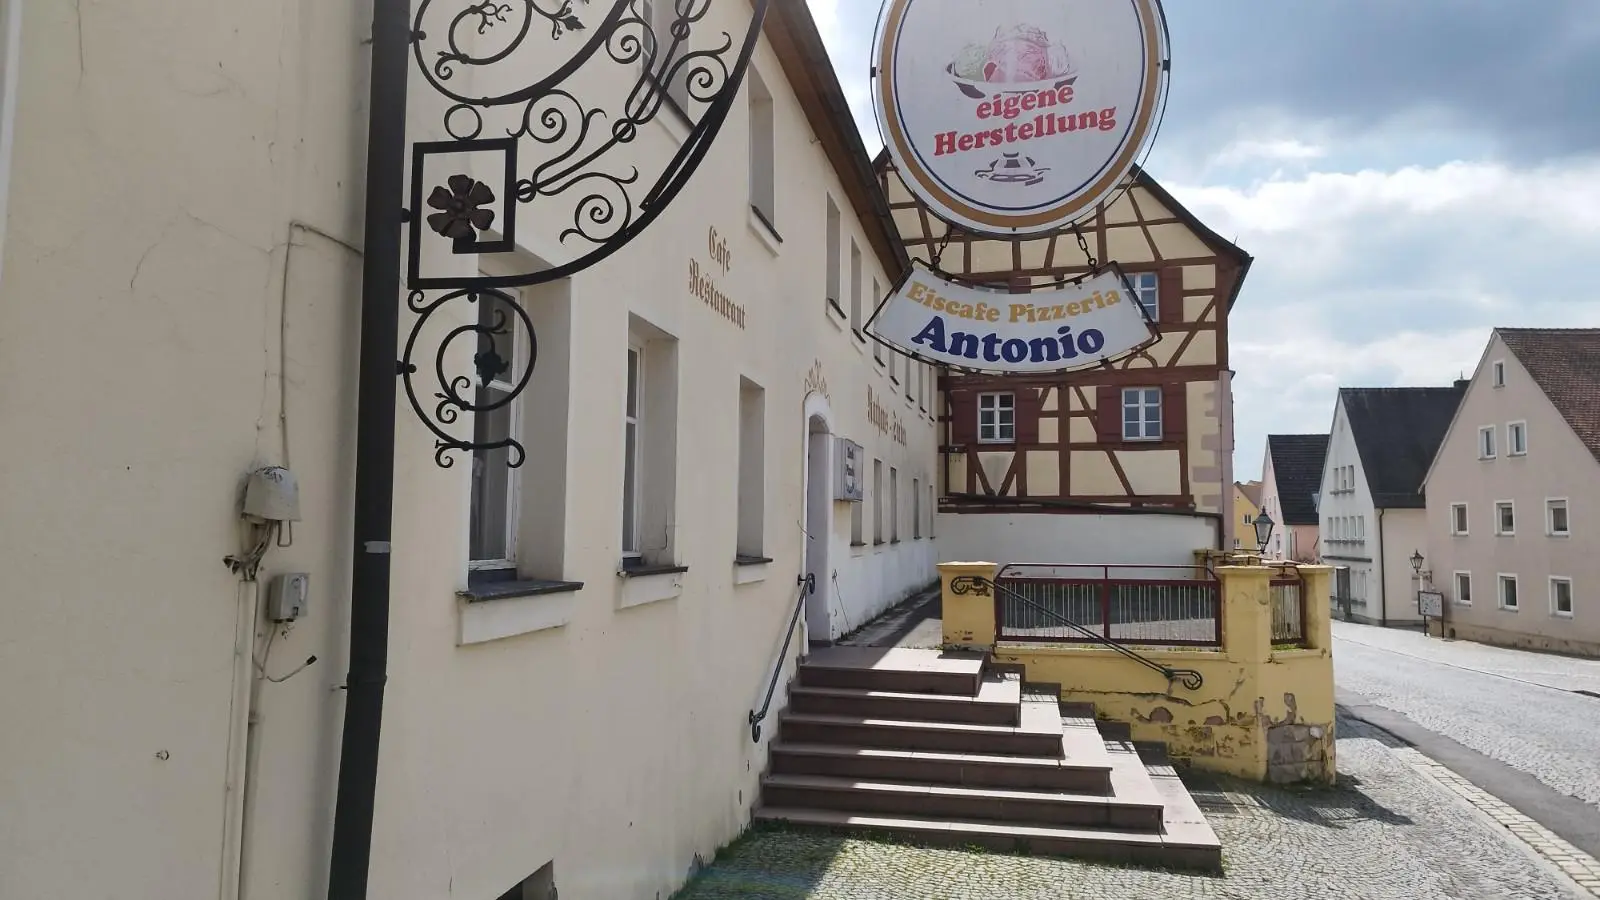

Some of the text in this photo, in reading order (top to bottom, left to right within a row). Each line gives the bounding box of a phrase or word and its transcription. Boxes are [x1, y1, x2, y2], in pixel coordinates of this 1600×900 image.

[976, 84, 1074, 120] eigene
[933, 105, 1117, 157] Herstellung
[708, 225, 731, 277] Cafe
[689, 257, 746, 330] Restaurant
[904, 280, 1121, 324] Eiscafe Pizzeria
[911, 315, 1105, 363] Antonio
